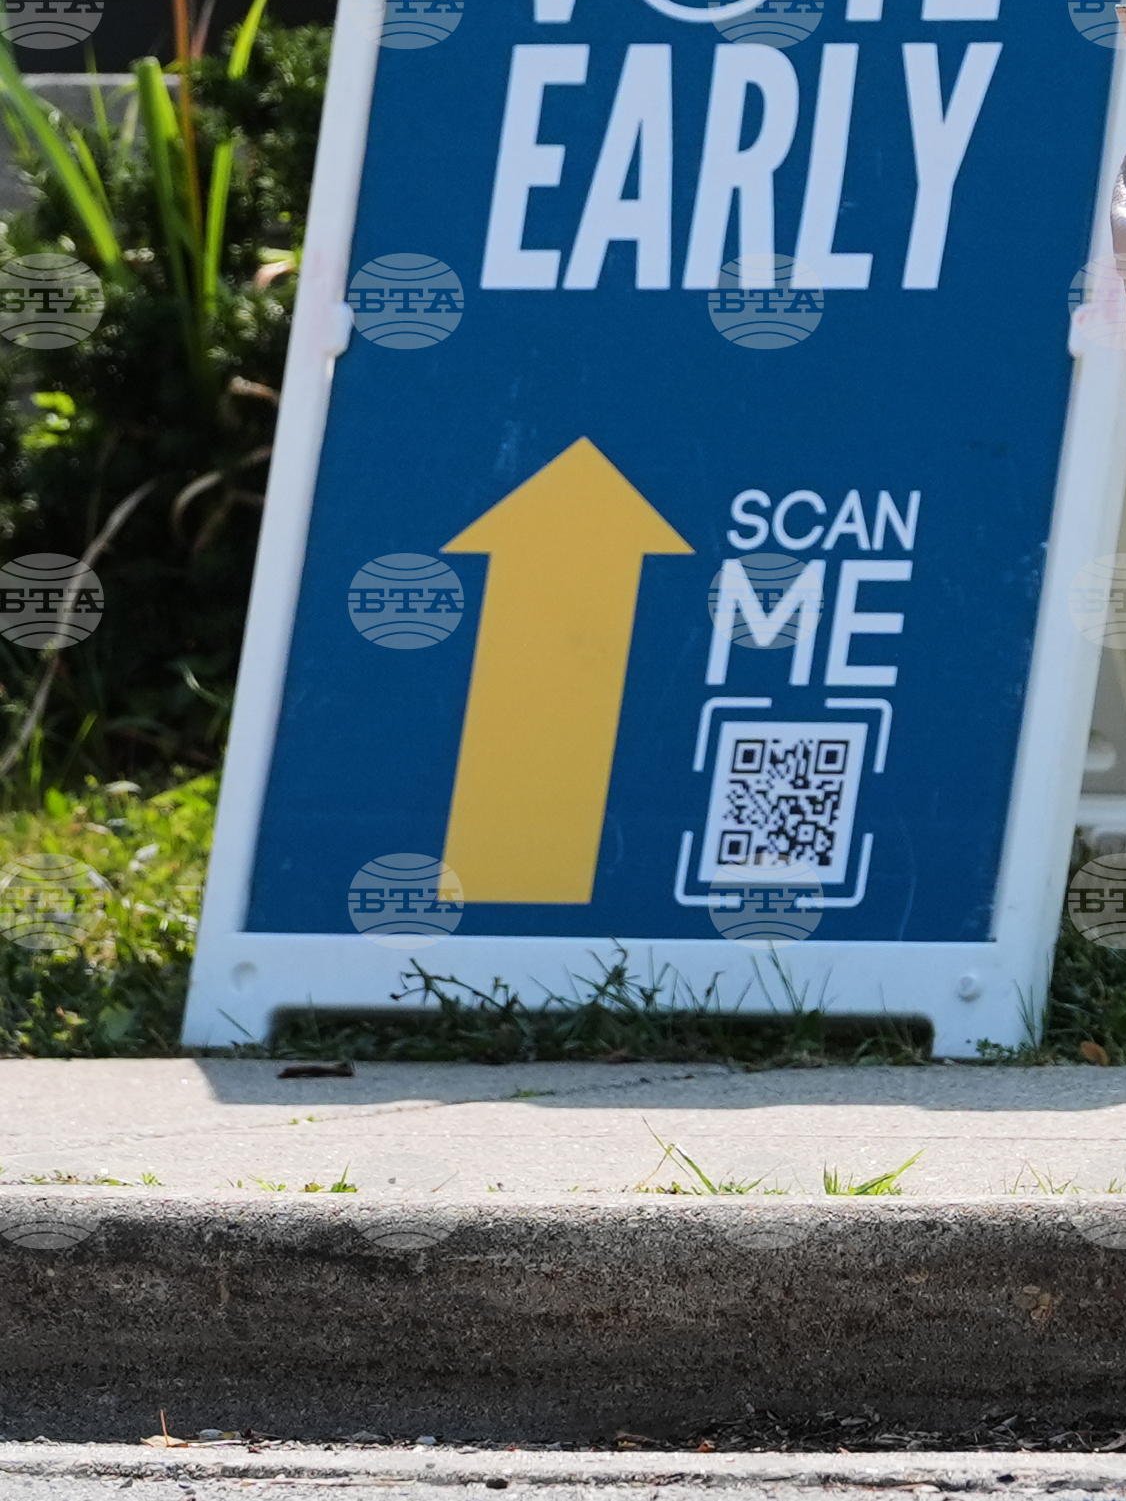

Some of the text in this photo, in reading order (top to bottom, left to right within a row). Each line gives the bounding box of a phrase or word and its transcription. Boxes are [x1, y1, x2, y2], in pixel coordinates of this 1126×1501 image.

[480, 43, 1003, 290] EARLY
[727, 489, 921, 551] SCAN
[705, 559, 913, 686] ME
